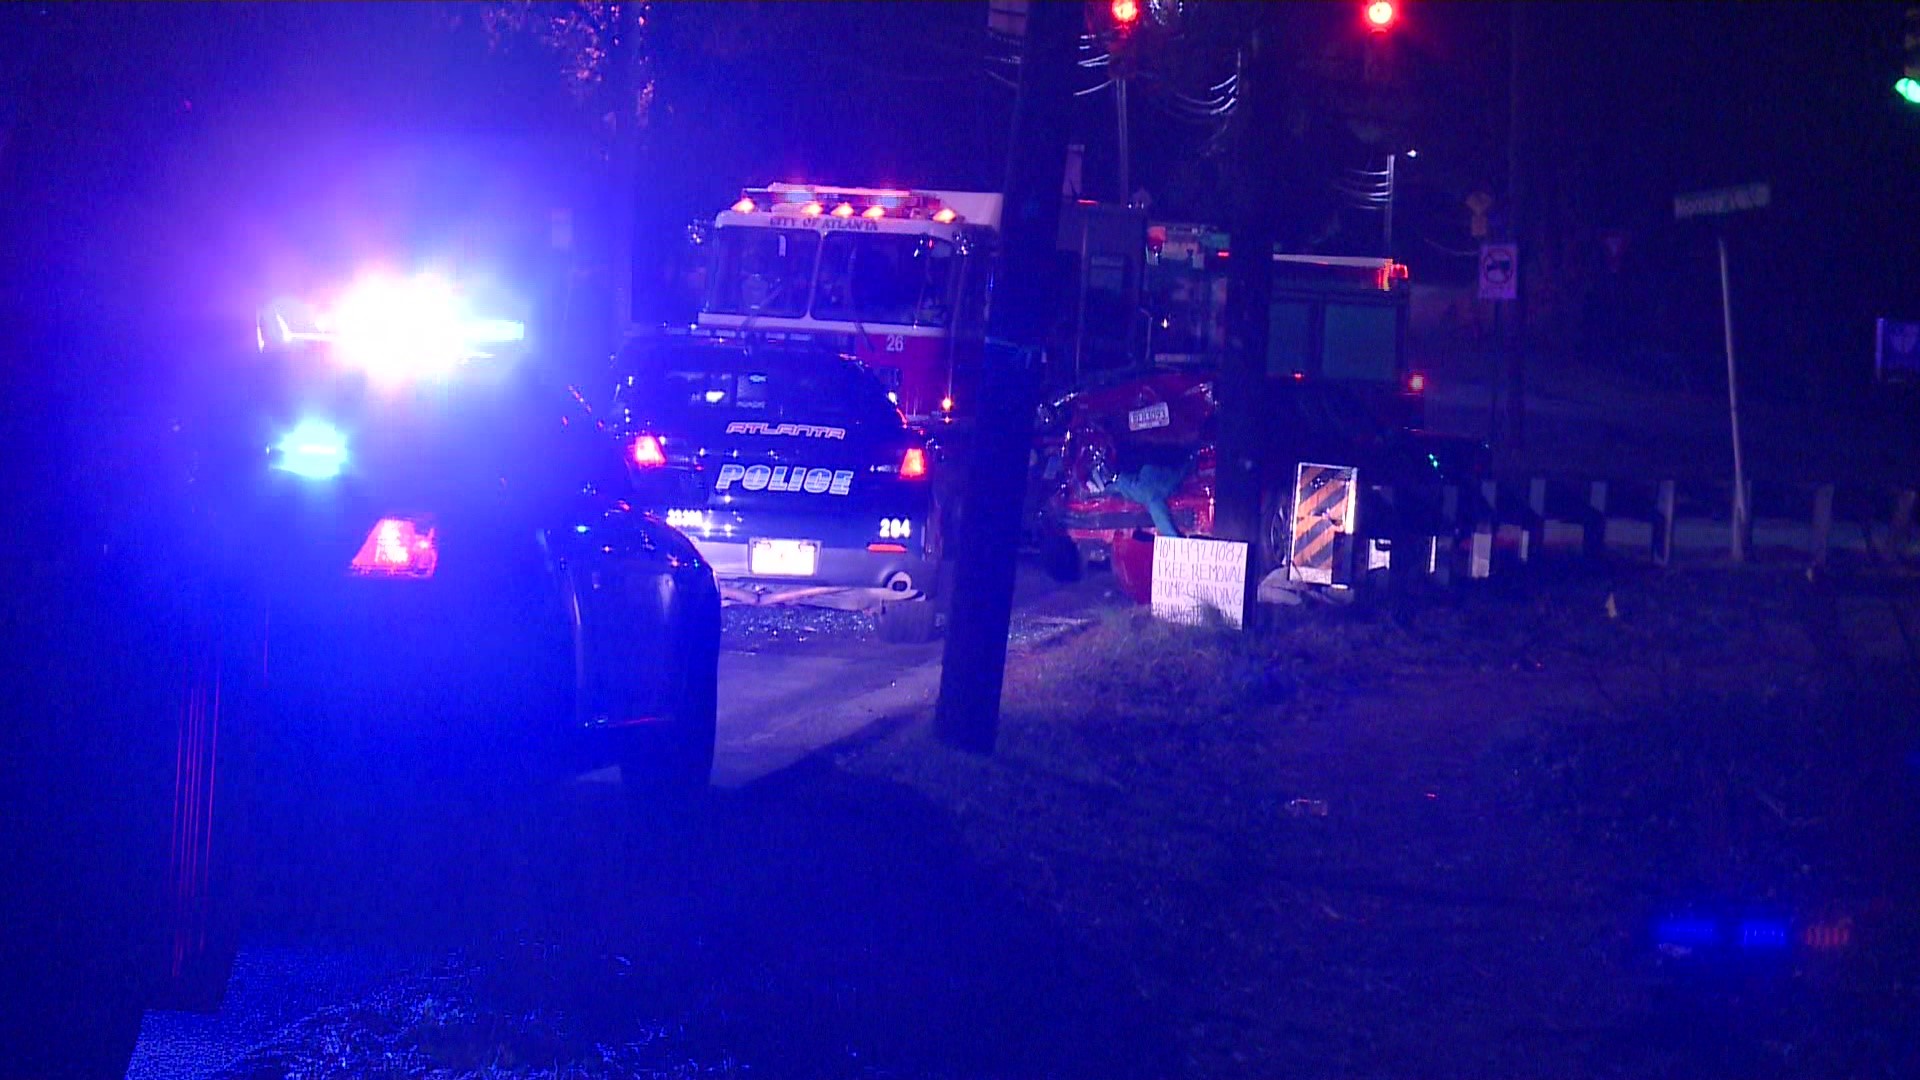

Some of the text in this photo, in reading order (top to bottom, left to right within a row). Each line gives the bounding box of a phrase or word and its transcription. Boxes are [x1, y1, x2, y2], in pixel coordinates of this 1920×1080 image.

[769, 217, 878, 231] CITY OF ATLANTA
[886, 334, 904, 352] 26
[725, 422, 846, 440] ATLANTA
[715, 464, 854, 496] POLICE
[1157, 559, 1243, 583] TREE REMOVAL
